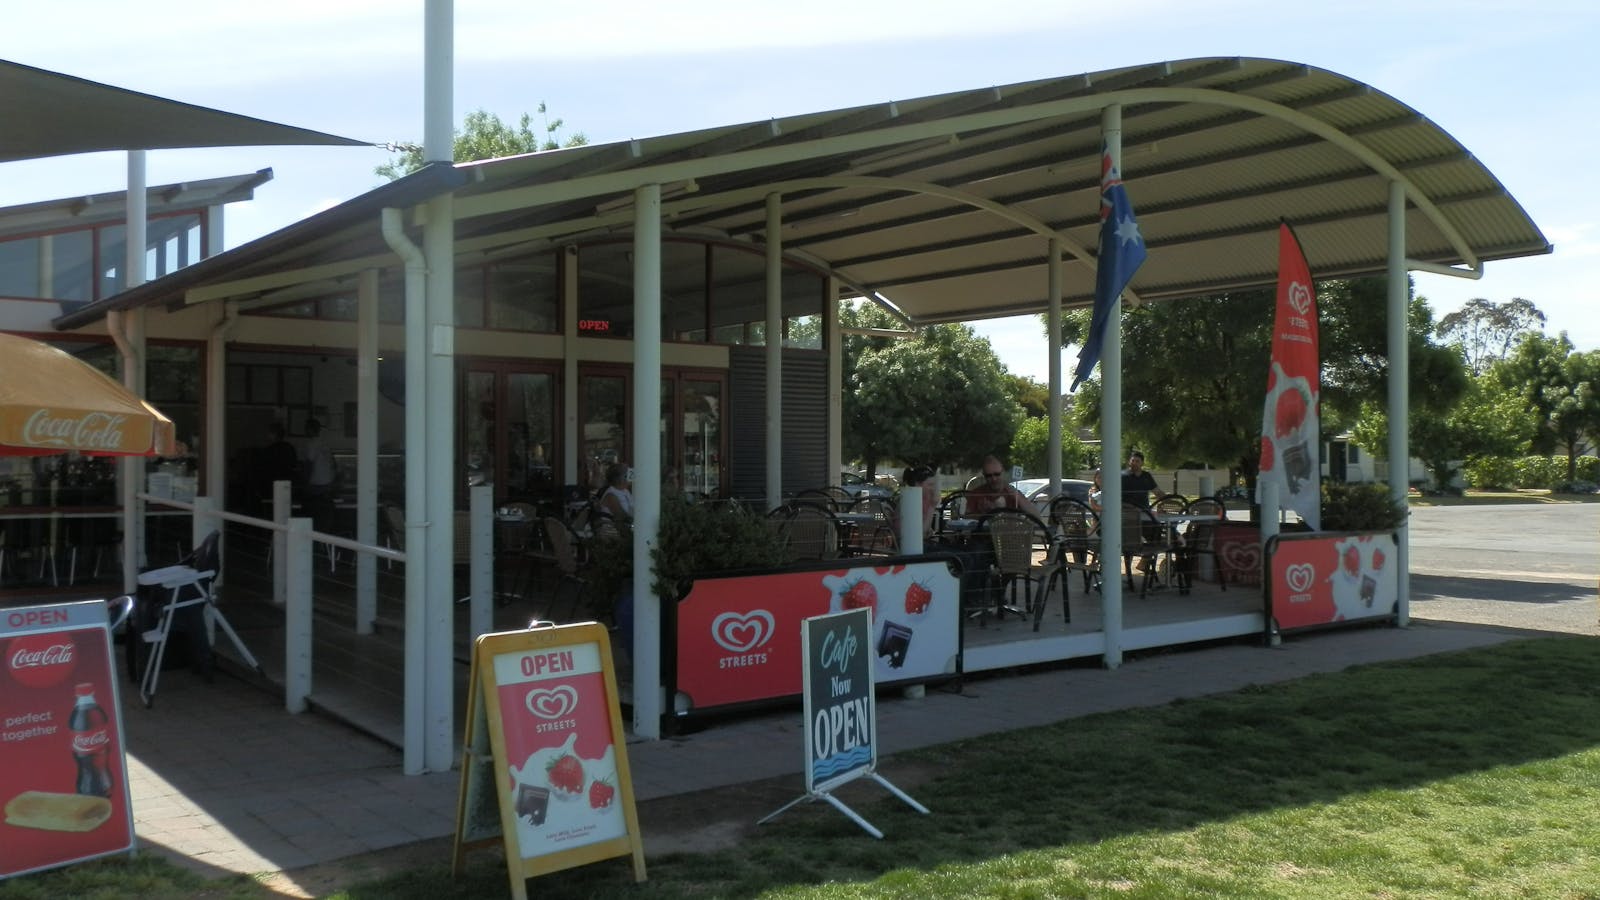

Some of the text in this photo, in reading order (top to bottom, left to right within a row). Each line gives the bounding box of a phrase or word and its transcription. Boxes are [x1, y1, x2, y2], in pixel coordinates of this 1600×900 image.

[579, 320, 609, 330] OPEN
[8, 608, 68, 628] OPEN
[520, 650, 574, 677] OPEN
[719, 653, 767, 669] STREETS
[831, 675, 852, 698] Now
[6, 711, 52, 728] perfect
[535, 719, 577, 733] STREETS
[2, 726, 58, 741] together
[814, 696, 869, 761] OPEN
